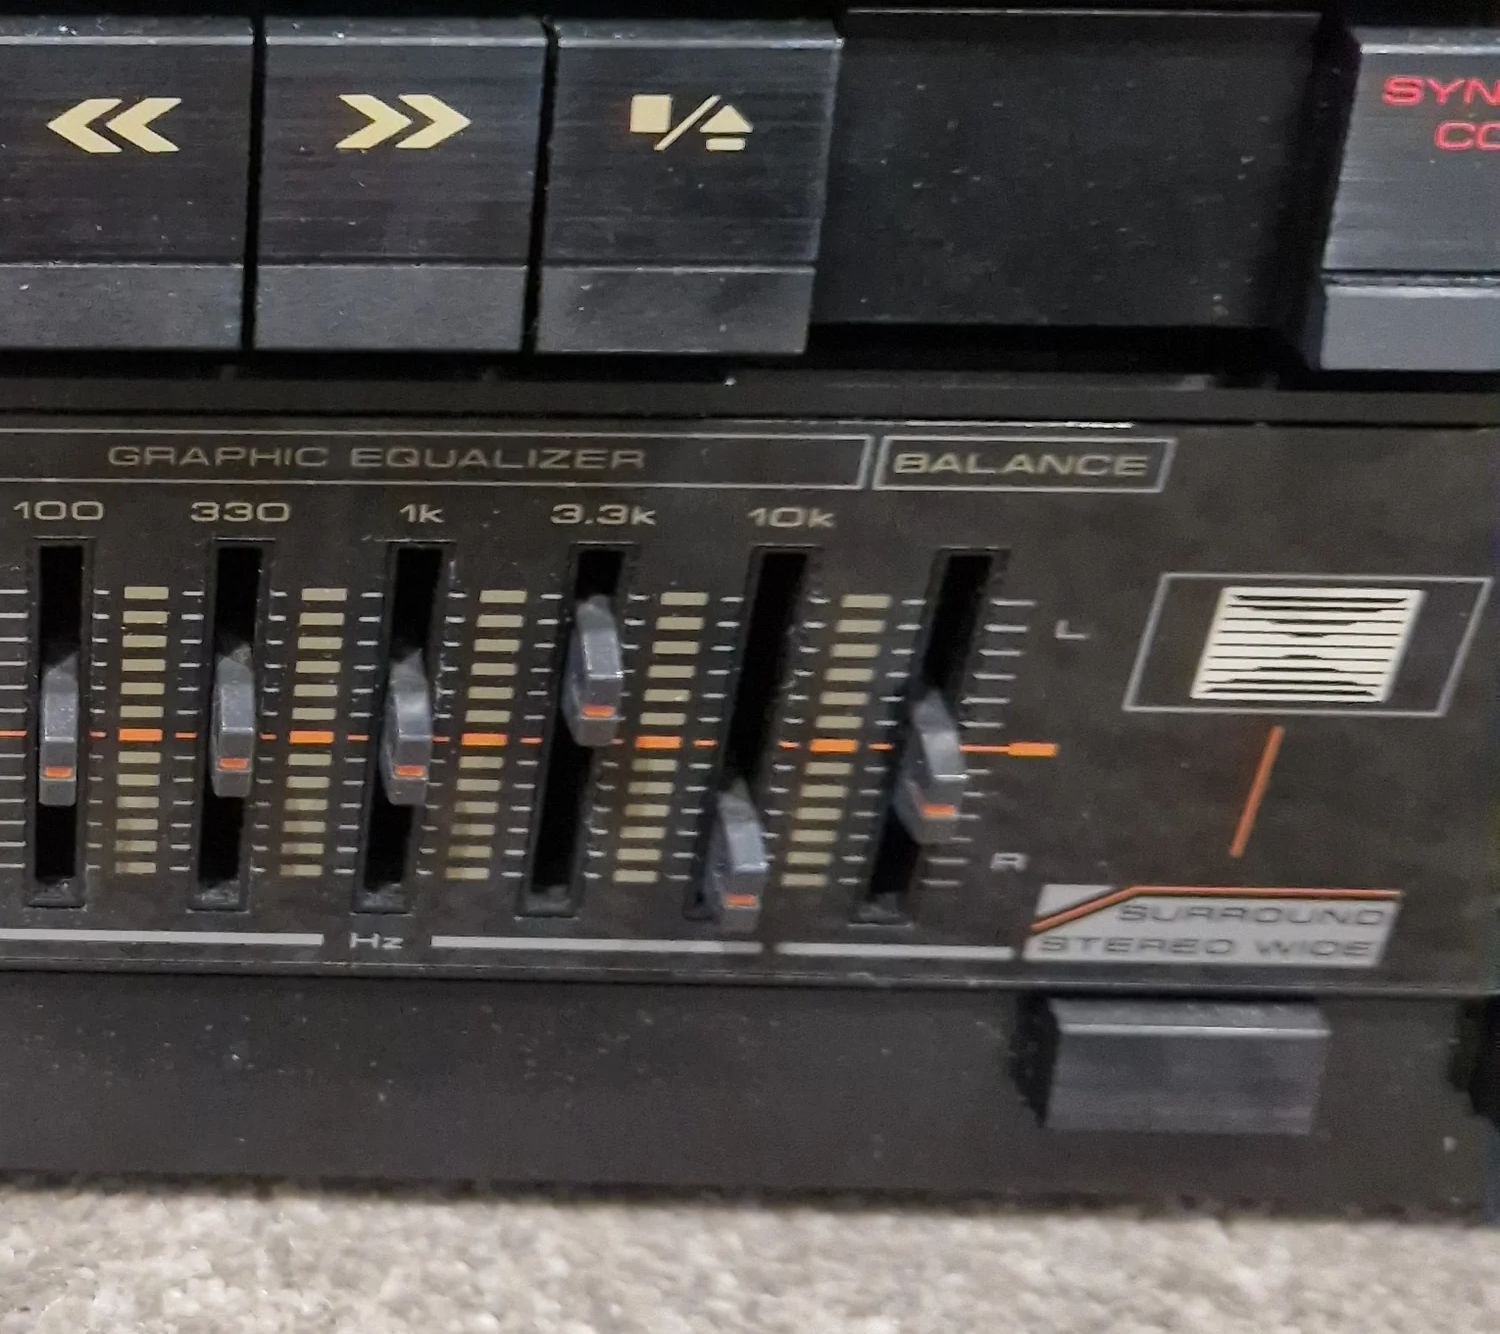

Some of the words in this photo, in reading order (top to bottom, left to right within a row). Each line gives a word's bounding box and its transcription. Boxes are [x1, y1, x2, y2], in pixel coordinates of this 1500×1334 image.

[106, 445, 329, 468] GRAPHIC
[349, 447, 647, 471] EQUALIZER
[893, 452, 1150, 478] BALANCE
[11, 500, 105, 523] 100
[189, 501, 291, 524] 330
[549, 504, 658, 527] 3.3k
[747, 507, 836, 530] 10k
[1117, 904, 1386, 925] SURROUND
[350, 931, 404, 951] Hz
[1039, 937, 1235, 957] STEREO
[1255, 941, 1374, 958] WIDE
